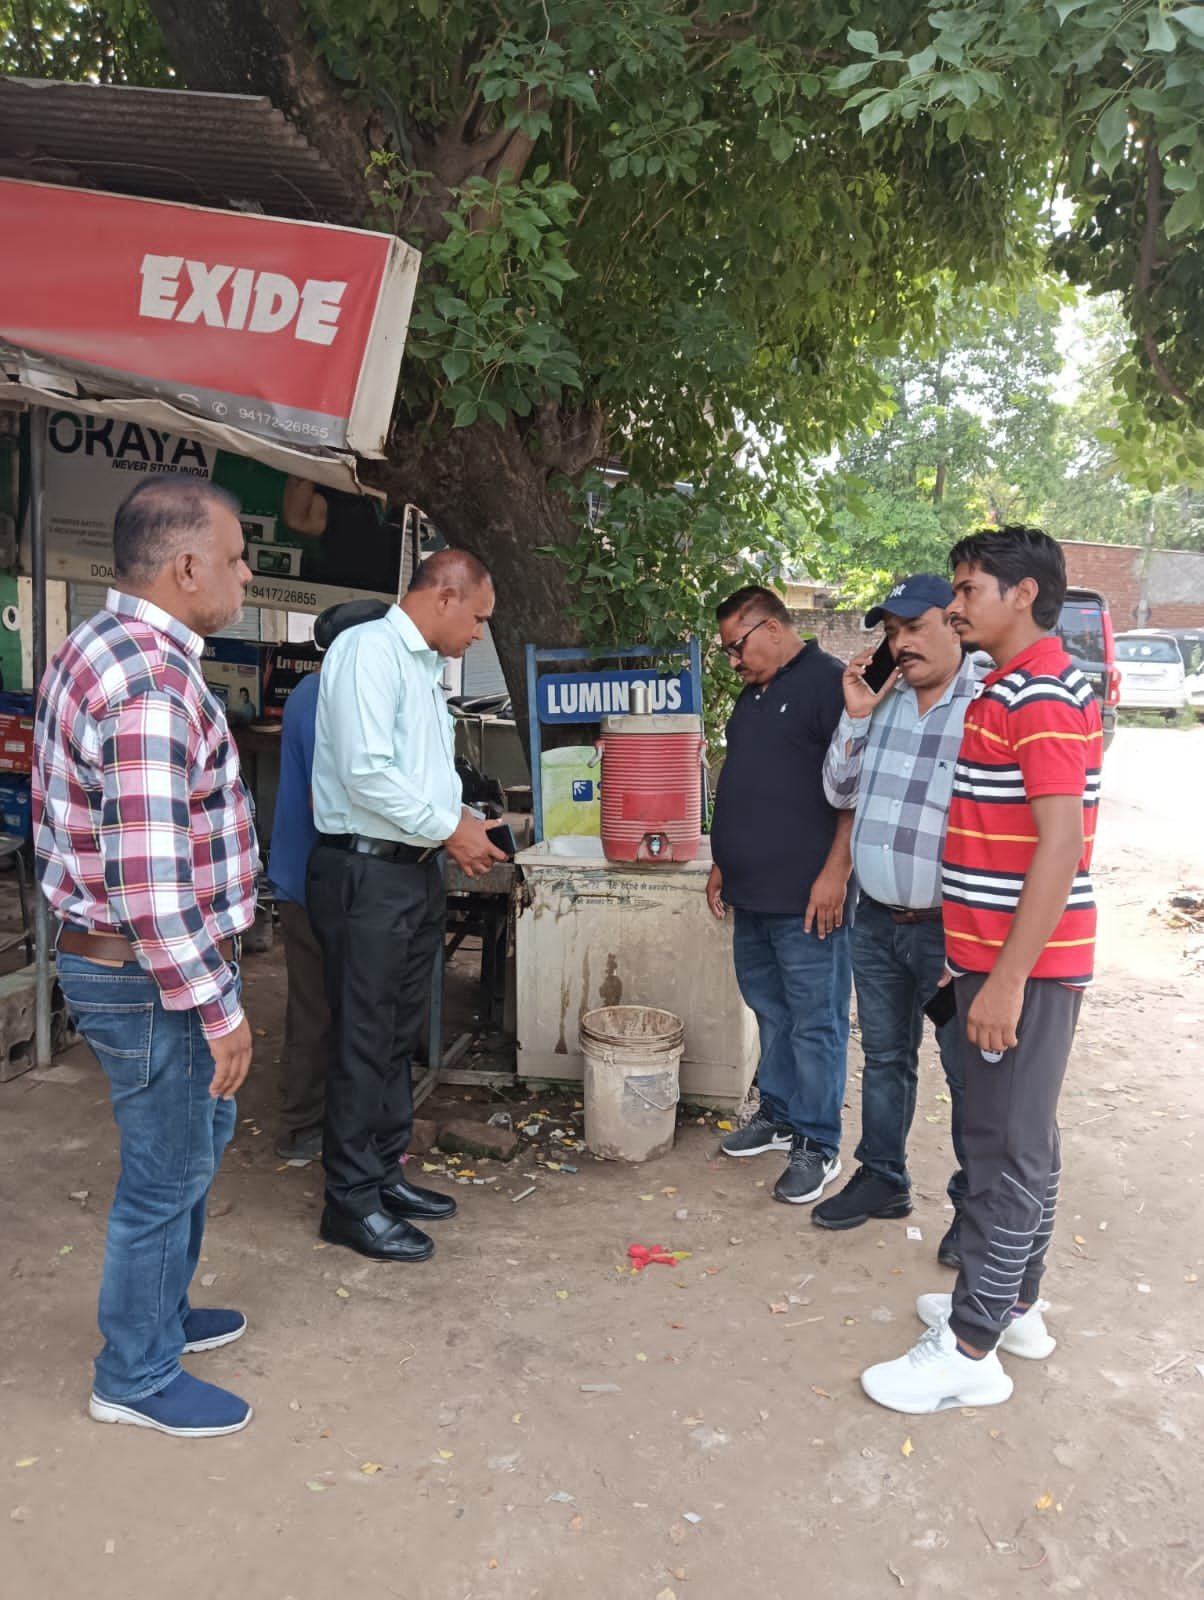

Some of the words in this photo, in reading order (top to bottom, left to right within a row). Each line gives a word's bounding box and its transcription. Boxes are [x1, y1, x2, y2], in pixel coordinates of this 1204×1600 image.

[139, 253, 347, 346] EXIDE
[48, 410, 208, 468] OKAYA
[239, 407, 329, 439] 94172-26855
[112, 459, 148, 473] NEVER
[90, 563, 117, 579] DOA
[251, 585, 317, 606] 9417226855
[547, 677, 683, 714] LUMINUS
